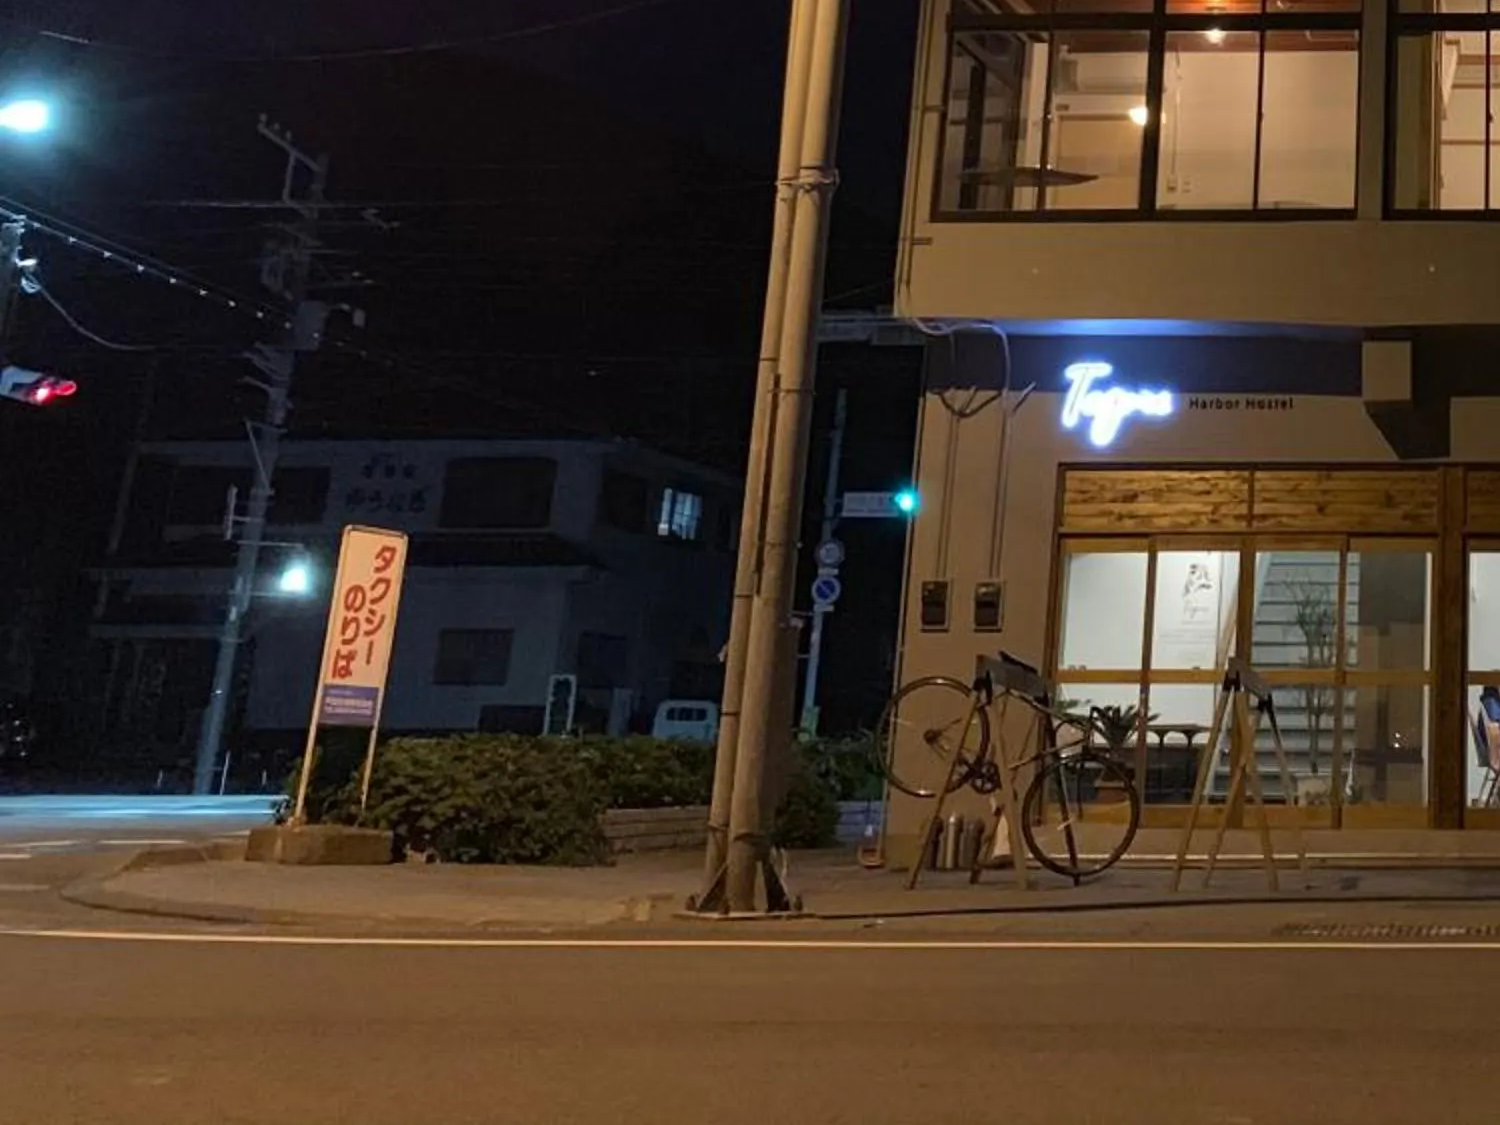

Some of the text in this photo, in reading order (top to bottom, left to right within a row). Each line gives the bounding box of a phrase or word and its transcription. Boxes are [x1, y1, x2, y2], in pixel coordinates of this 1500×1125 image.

[1189, 397, 1240, 410] Harbor
[331, 583, 366, 680] のりば
[364, 544, 398, 665] タクシー
